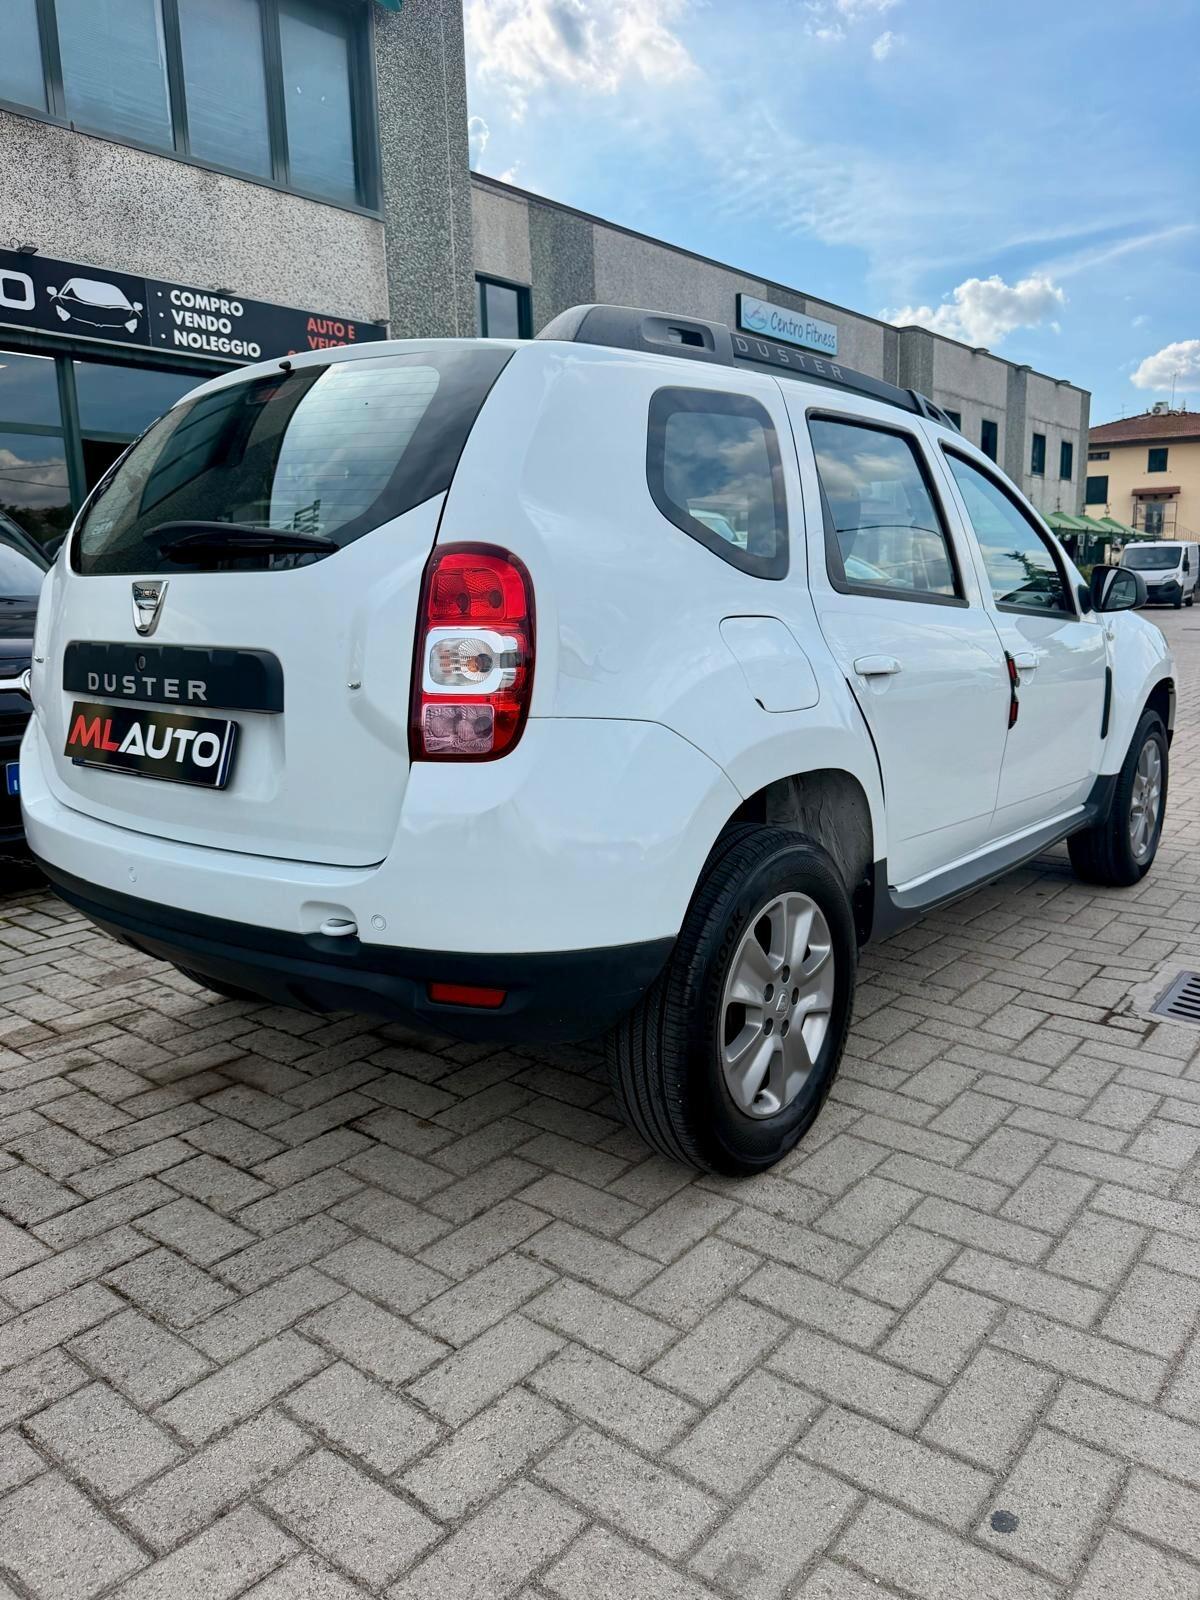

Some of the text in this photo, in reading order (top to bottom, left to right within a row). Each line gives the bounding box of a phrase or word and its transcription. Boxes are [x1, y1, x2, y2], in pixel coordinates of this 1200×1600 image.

[170, 290, 244, 317] COMPRO
[171, 309, 232, 334] VENDO
[307, 317, 356, 339] AUTO E
[771, 312, 836, 349] Centro Fitness
[174, 329, 261, 358] NOLEGGIO
[736, 338, 844, 380] DUSTER
[87, 672, 208, 701] DUSTER
[68, 714, 221, 768] MLAUTO
